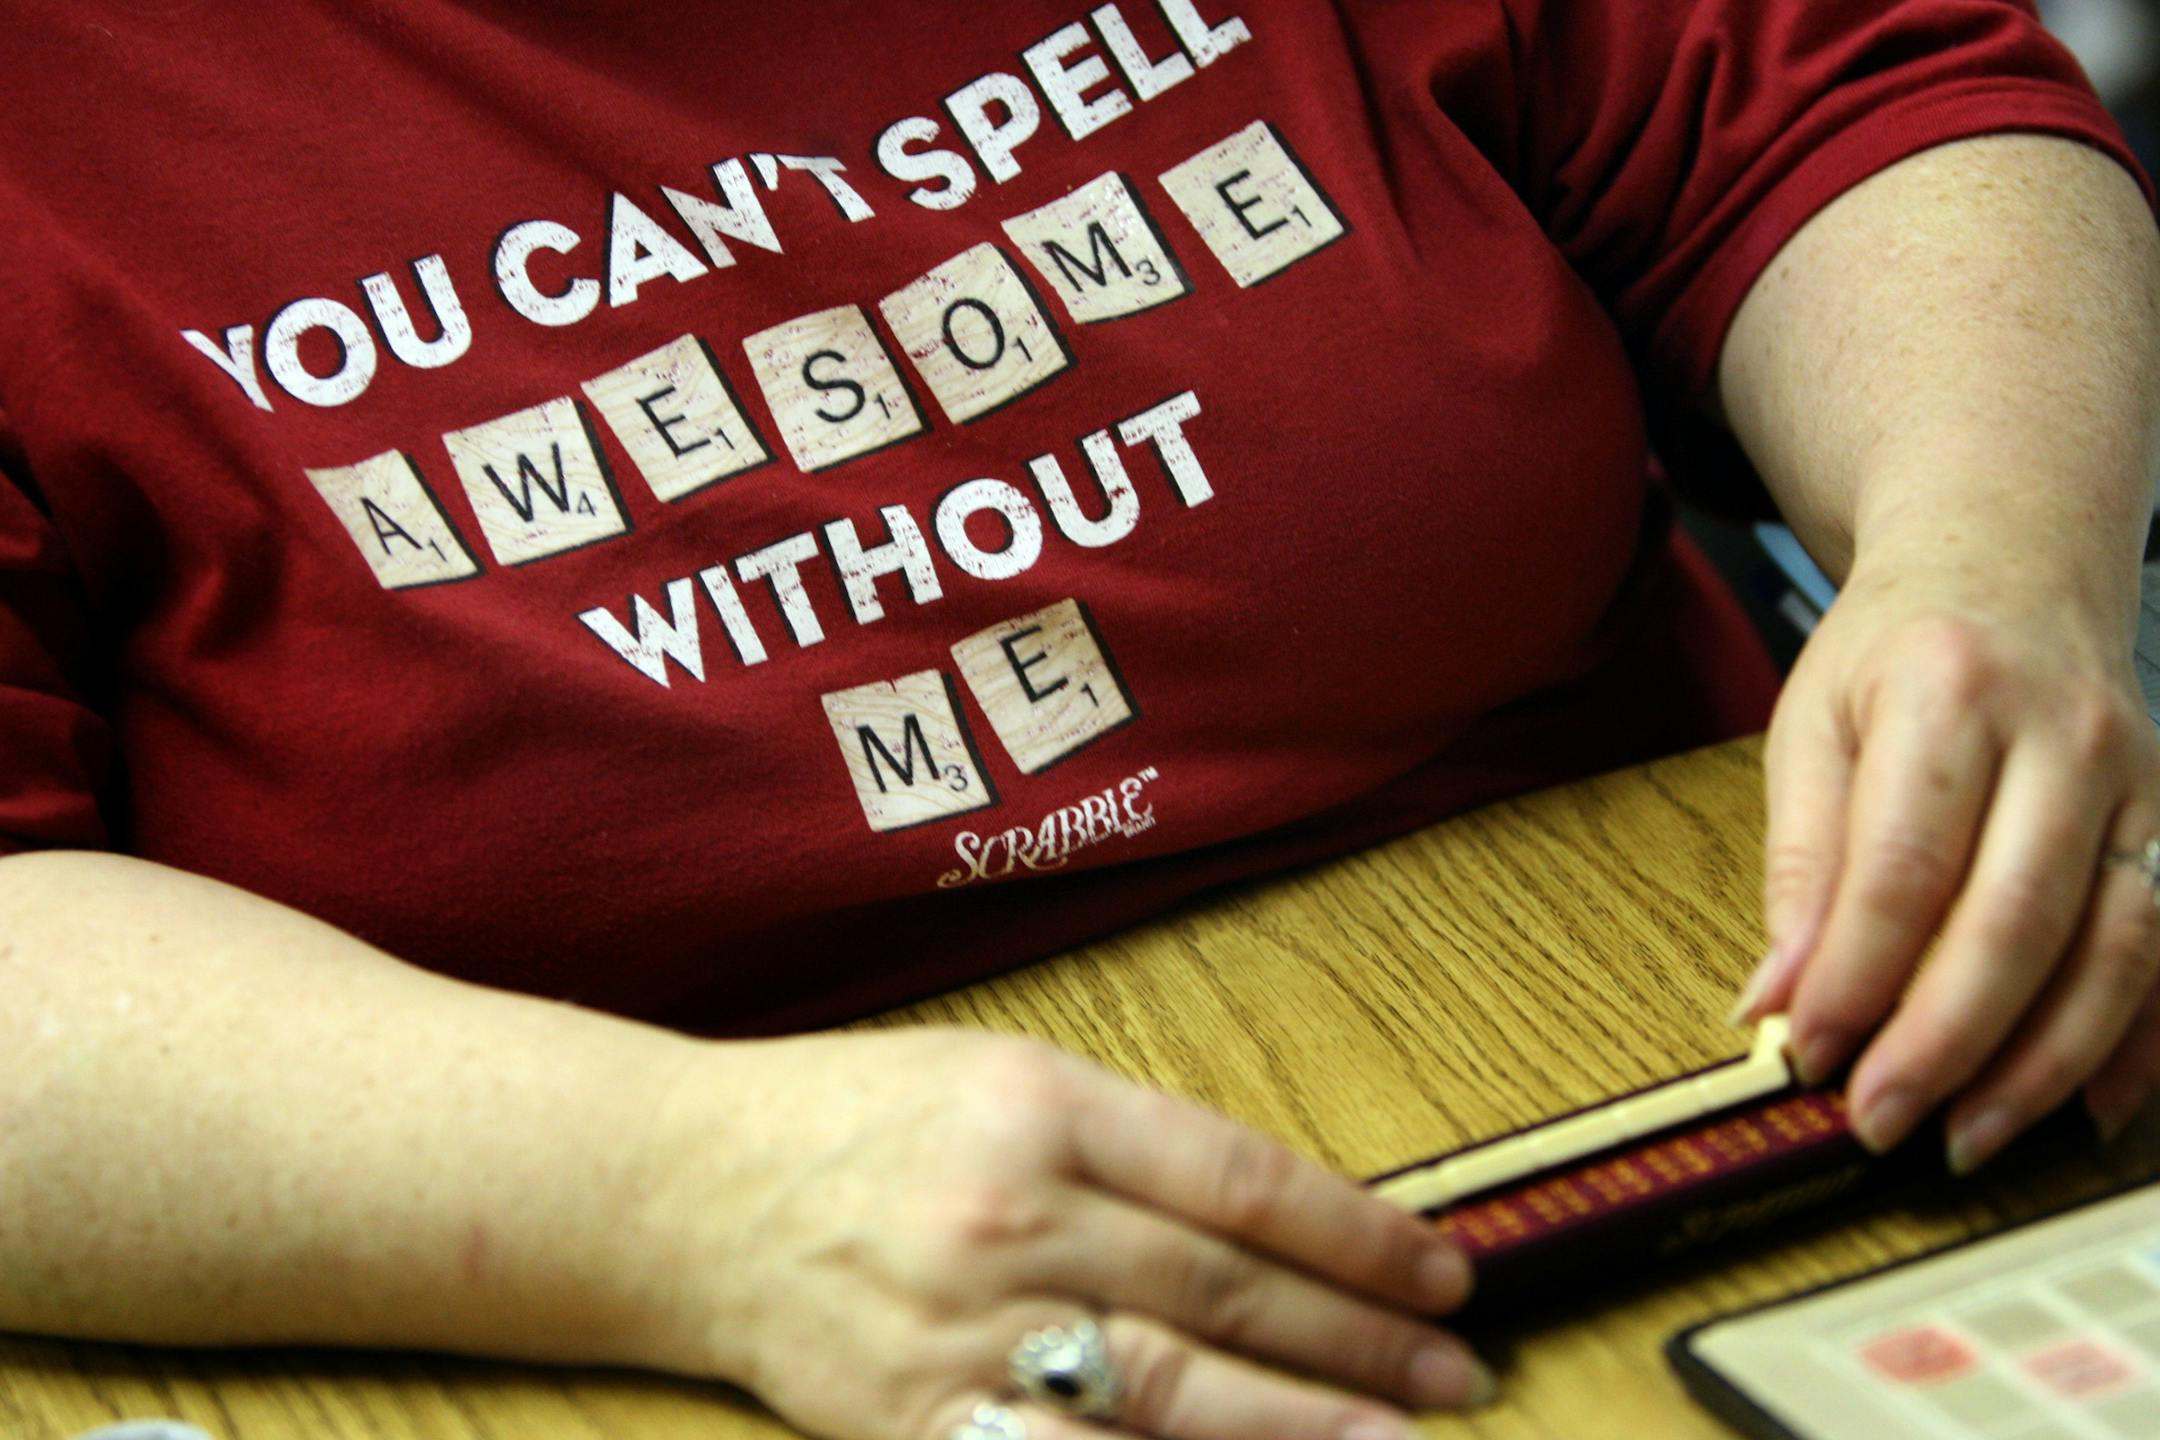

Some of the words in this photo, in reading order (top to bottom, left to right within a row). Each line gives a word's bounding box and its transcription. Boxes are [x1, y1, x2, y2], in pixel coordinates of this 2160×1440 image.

[180, 253, 473, 413] YOU
[494, 152, 876, 326] CAN'T
[875, 0, 1253, 211] SPELL
[576, 390, 1215, 688] WITHOUT
